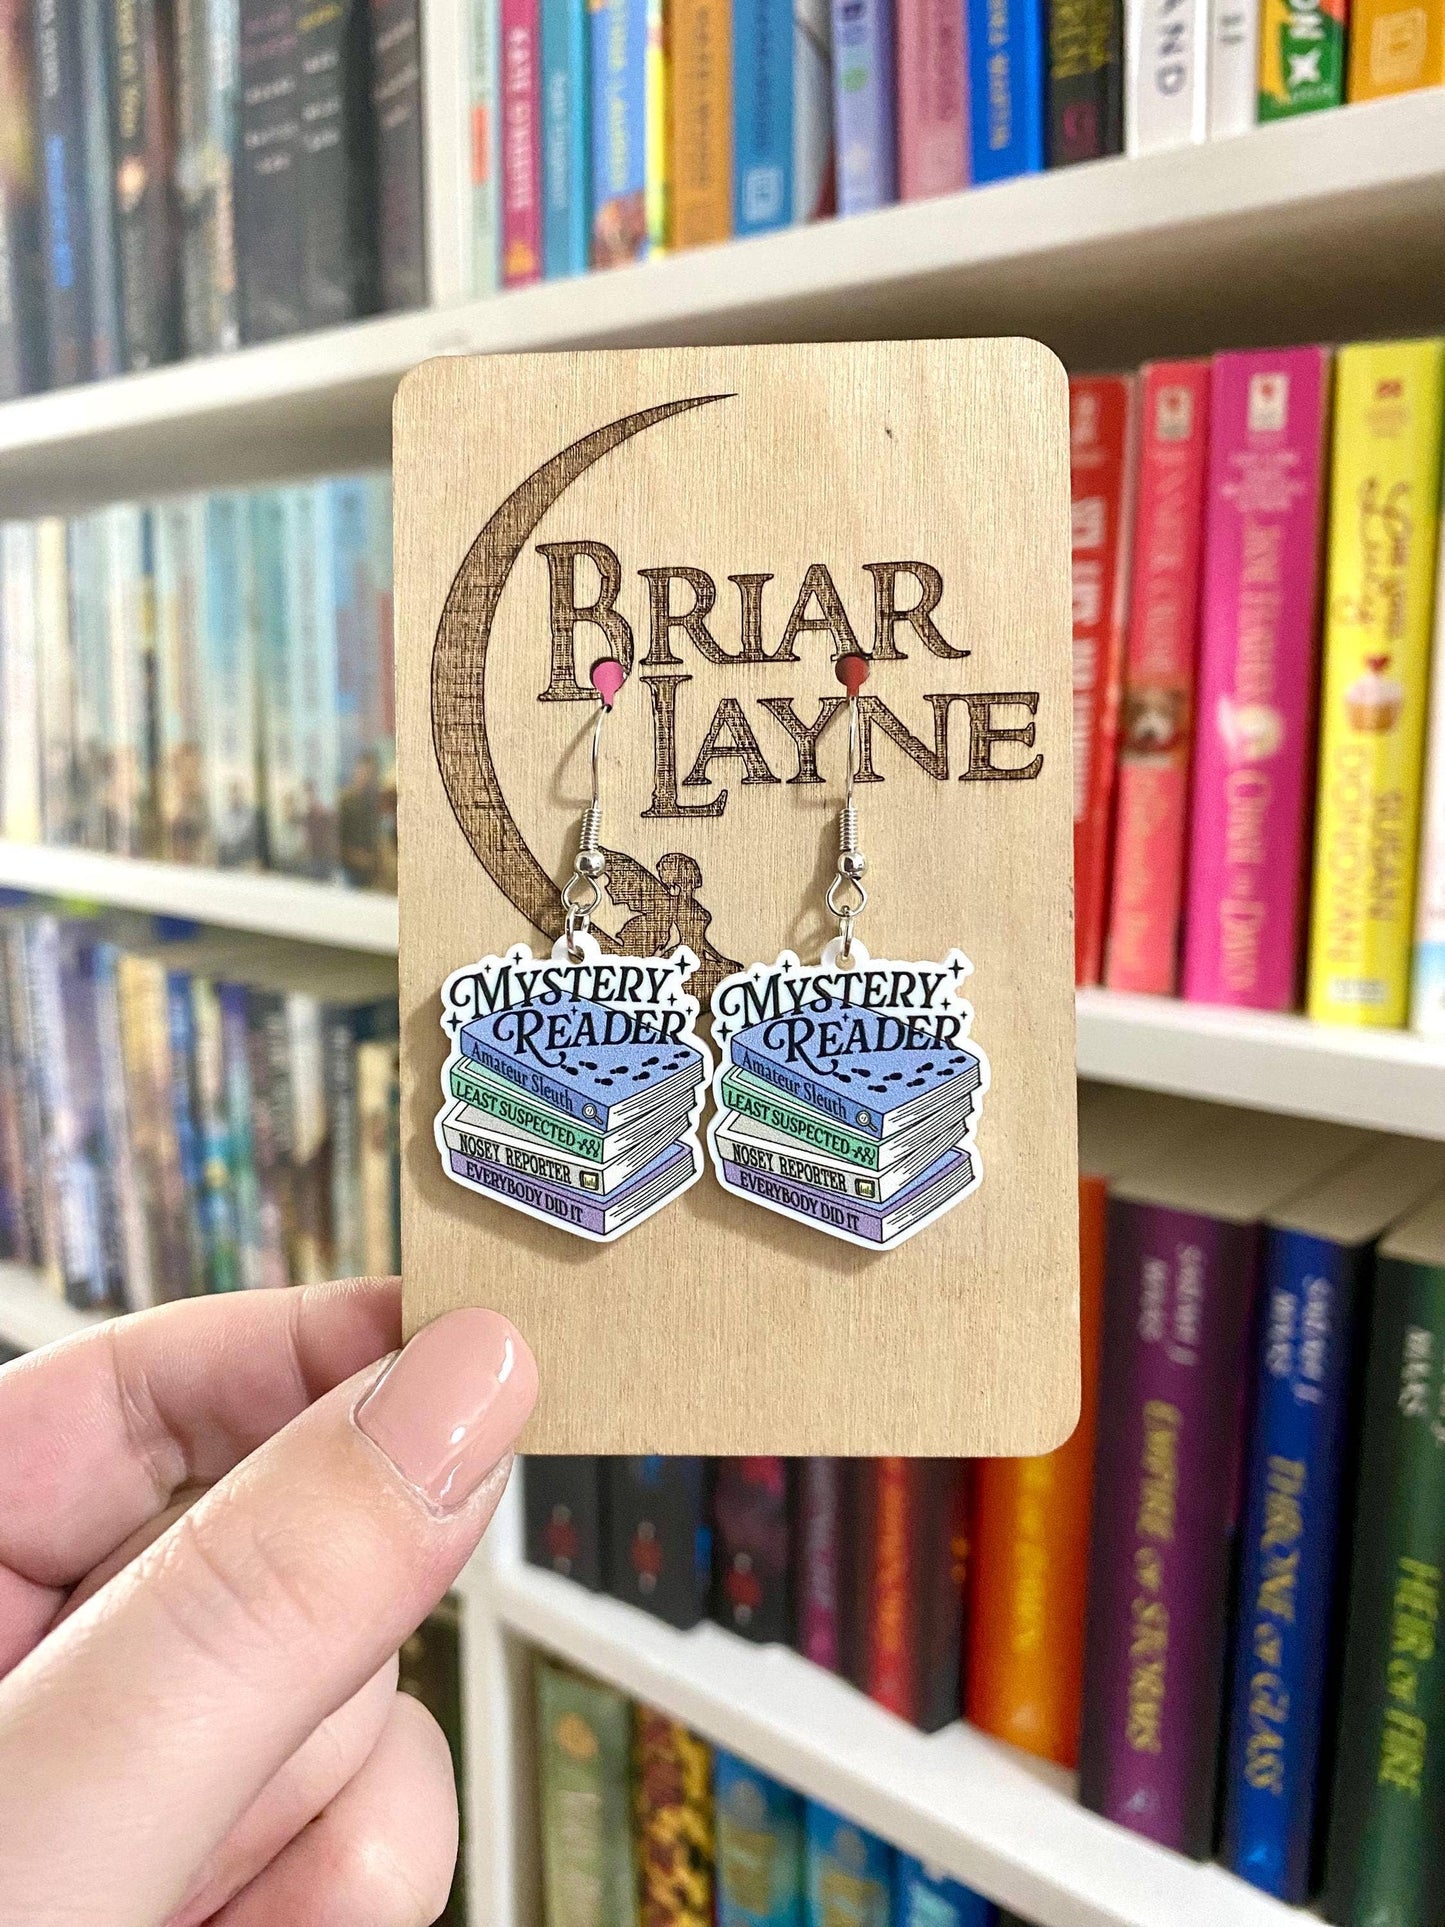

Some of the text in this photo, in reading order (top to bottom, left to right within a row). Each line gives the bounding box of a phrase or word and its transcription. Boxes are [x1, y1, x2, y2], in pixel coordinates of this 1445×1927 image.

[535, 540, 971, 702] BRIAR
[639, 673, 1045, 819] LAYNE
[450, 965, 675, 1019] MYSTERY
[719, 971, 947, 1029] MYSTERY
[493, 1009, 686, 1068] READER
[763, 1015, 962, 1075] READER
[471, 1042, 574, 1112] Amateur Sleuth
[742, 1052, 847, 1120] Amateur Sleuth
[456, 1080, 576, 1146] LEAST SUSPECTED
[728, 1090, 850, 1155] LEAST SUSPECTED
[459, 1133, 572, 1185] NOSEY REPORTER
[466, 1161, 583, 1223] EVERYBODY DID IT
[732, 1143, 847, 1193] NOSEY REPORTER
[740, 1169, 860, 1232] EVERYBODY DID IT
[1136, 1399, 1182, 1542] EMPIRE
[1256, 1454, 1308, 1624] THRONE
[1392, 1556, 1444, 1661] HEIR
[1125, 1597, 1170, 1755] STORMS
[1245, 1671, 1290, 1796] GLASS
[1378, 1707, 1428, 1797] FIRE
